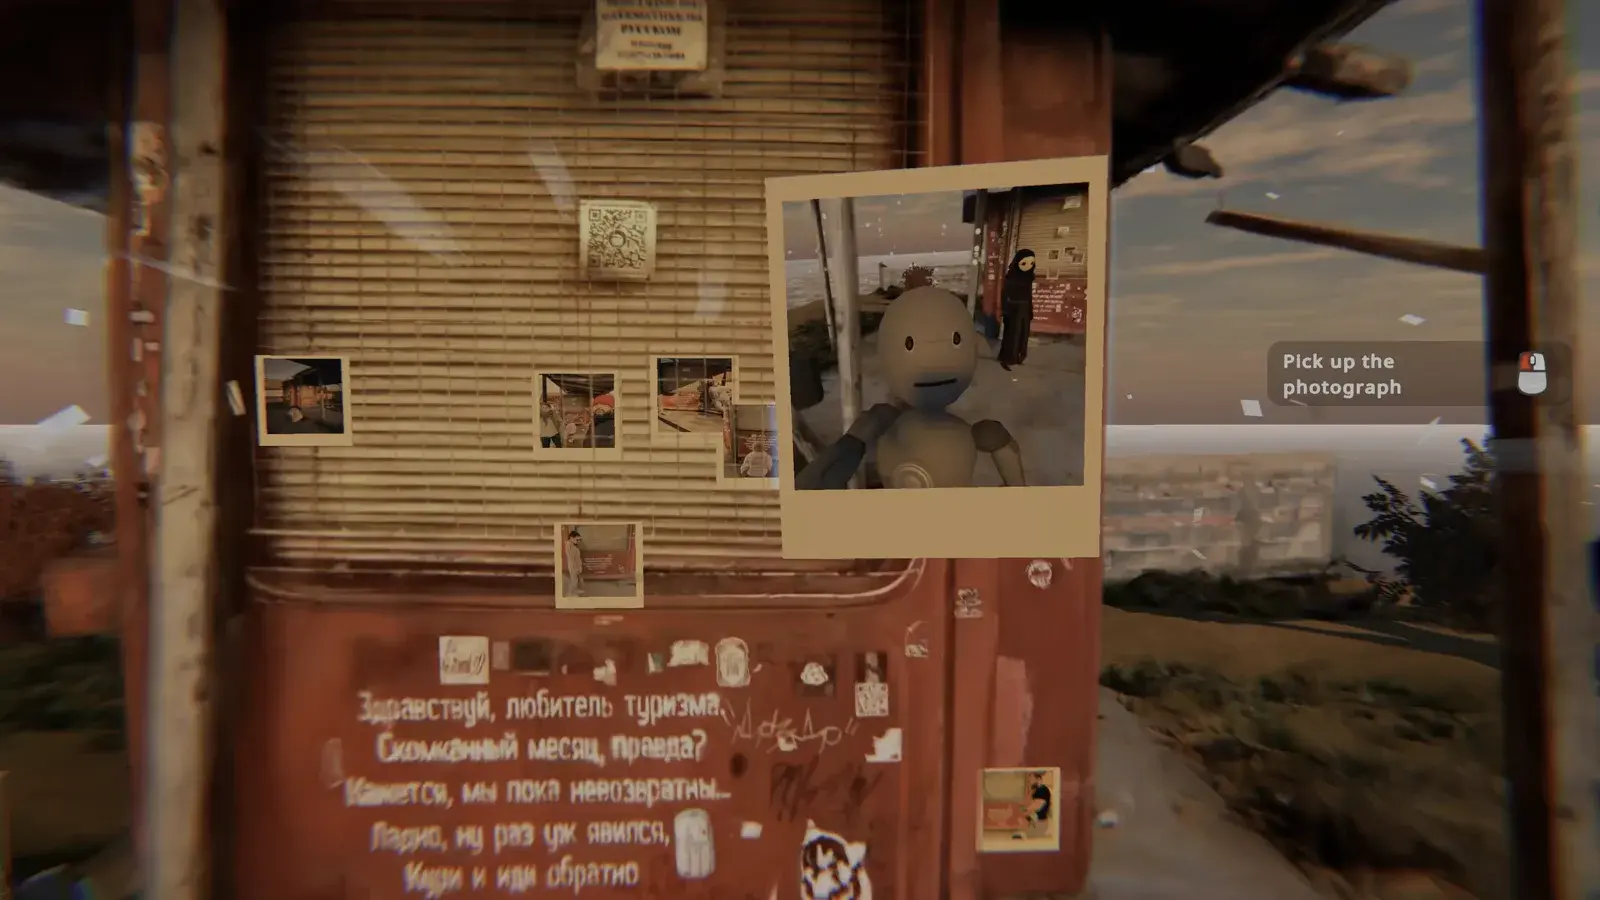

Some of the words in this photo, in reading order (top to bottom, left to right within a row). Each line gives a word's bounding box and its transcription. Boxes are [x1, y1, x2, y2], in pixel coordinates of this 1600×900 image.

[506, 689, 613, 719] любитель
[611, 728, 707, 766] правда?
[462, 781, 497, 804] мы
[507, 779, 561, 802] пока
[456, 825, 483, 855] ну
[494, 822, 534, 854] раз
[543, 821, 578, 852] уж
[587, 820, 670, 847] явился,
[472, 866, 486, 891] и
[497, 864, 536, 894] иди
[547, 855, 639, 895] обратно
